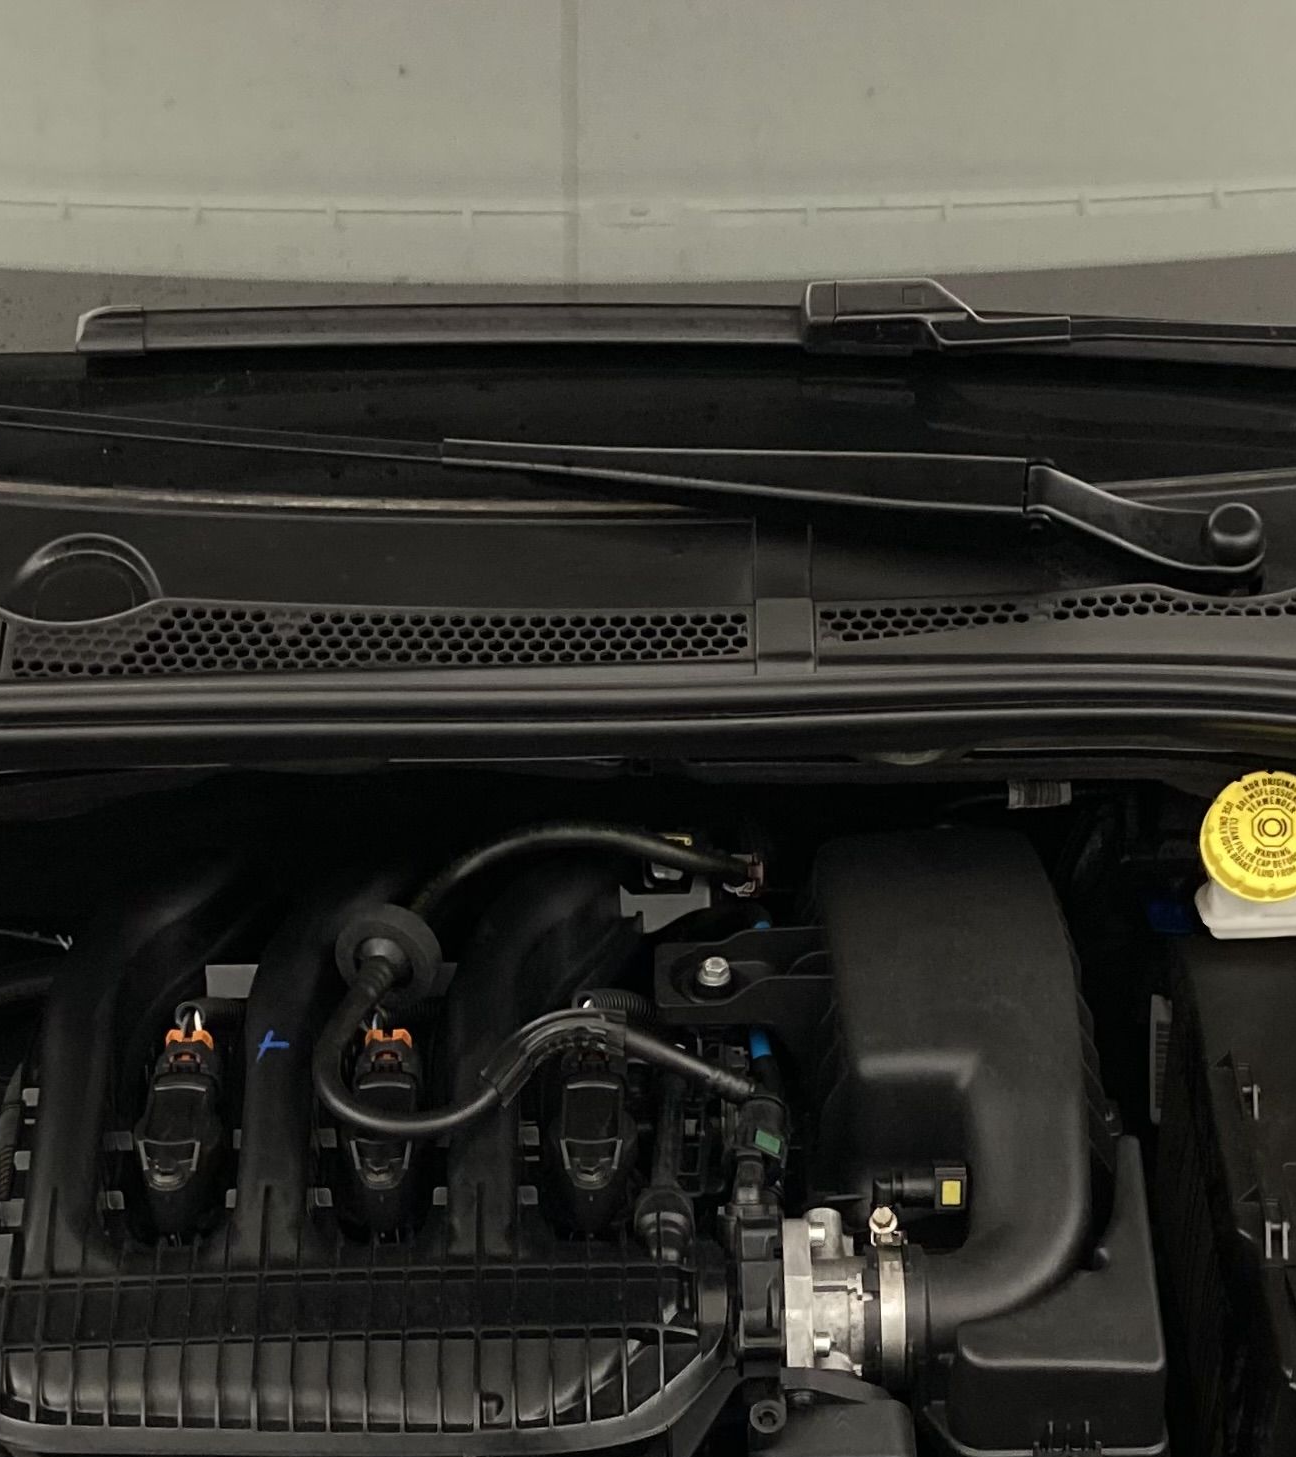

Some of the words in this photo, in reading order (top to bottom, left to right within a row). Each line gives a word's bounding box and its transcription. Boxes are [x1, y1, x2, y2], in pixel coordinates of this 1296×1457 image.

[1255, 847, 1291, 858] WARNING
[1230, 852, 1251, 872] BRAKE
[1256, 857, 1272, 867] CAP
